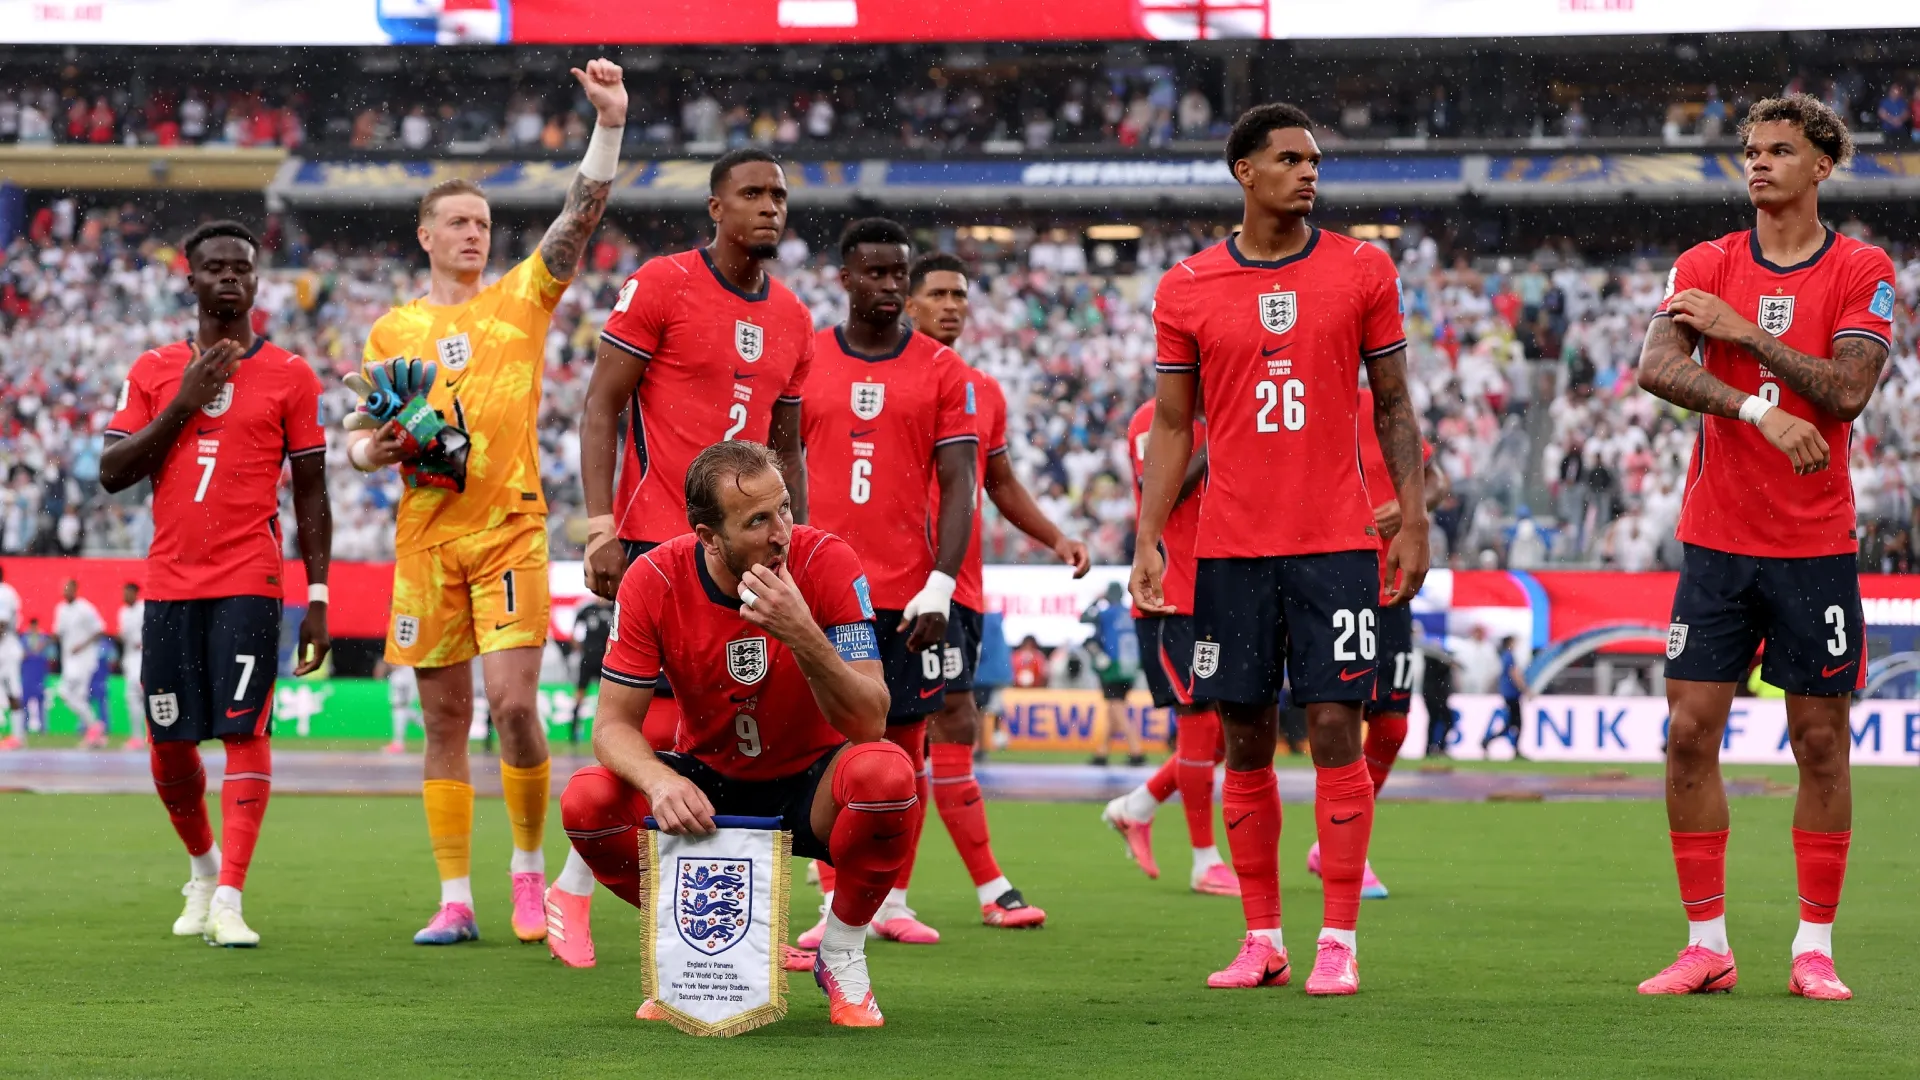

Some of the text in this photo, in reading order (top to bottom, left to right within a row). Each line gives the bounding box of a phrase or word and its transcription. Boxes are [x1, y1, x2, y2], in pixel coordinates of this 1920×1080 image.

[1267, 360, 1292, 368] PANAMA
[723, 402, 748, 441] 2
[1255, 378, 1306, 433] 26
[193, 455, 217, 503] 7
[850, 458, 873, 504] 6
[502, 570, 516, 614] 1
[835, 623, 868, 633] FOOTBALL
[836, 631, 870, 643] UNITES
[1332, 608, 1376, 661] 26
[1824, 604, 1848, 657] 3
[233, 654, 256, 701] 7
[921, 644, 941, 680] 6
[735, 714, 762, 758] 9
[1003, 704, 1095, 738] NEW
[686, 961, 708, 969] England
[679, 993, 702, 1001] Saturday
